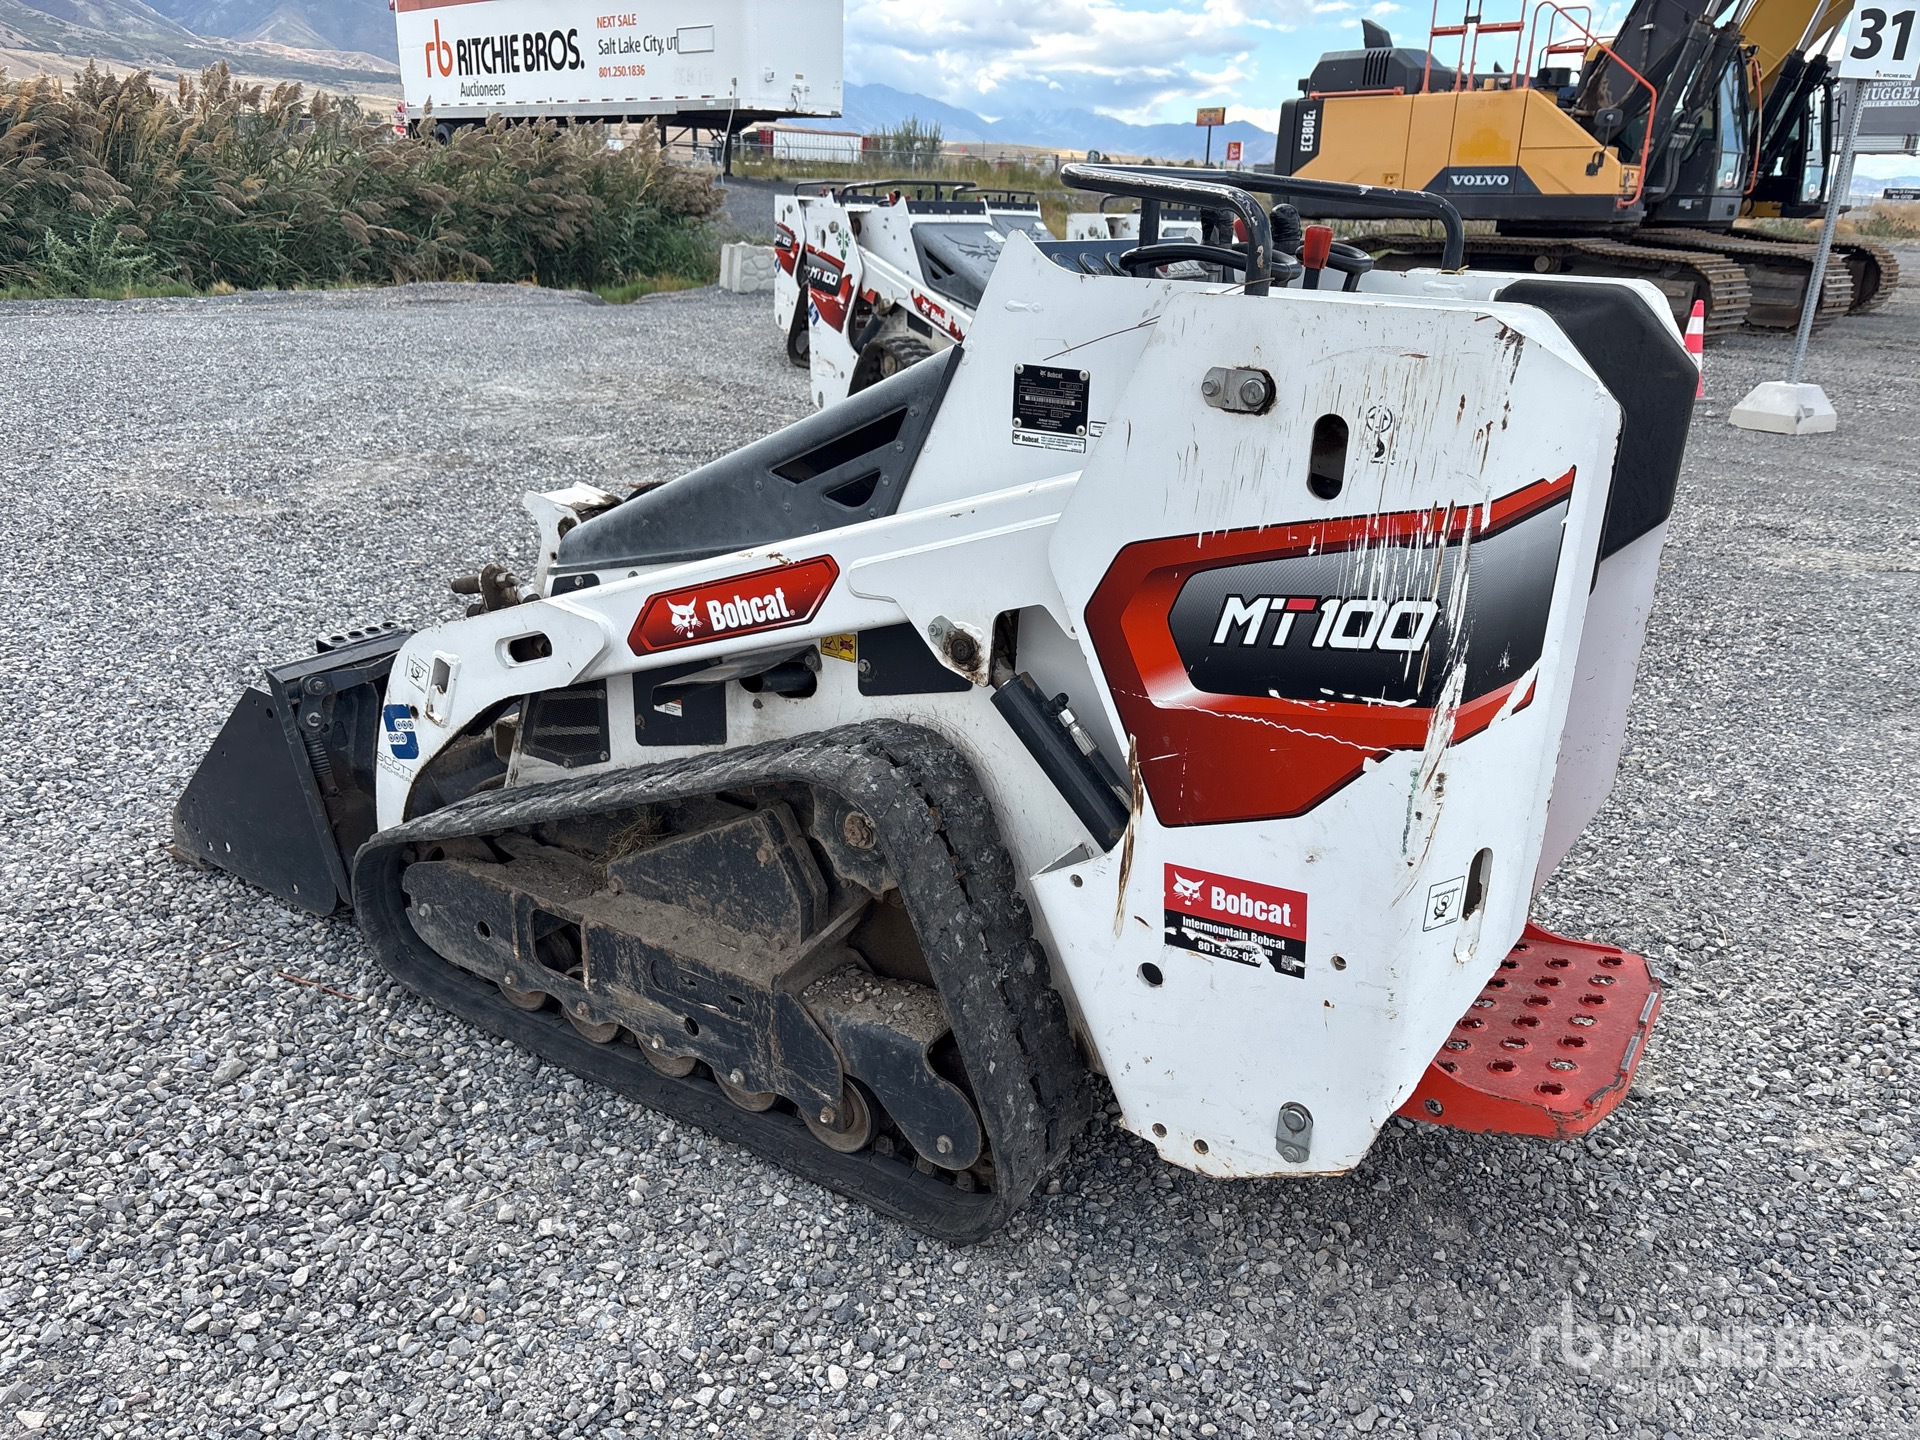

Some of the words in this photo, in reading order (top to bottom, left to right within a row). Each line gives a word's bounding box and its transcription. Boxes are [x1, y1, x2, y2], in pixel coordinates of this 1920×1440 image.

[596, 15, 616, 29] NEXT
[618, 13, 637, 27] SALE
[1849, 8, 1916, 61] 31
[425, 19, 453, 78] rb
[456, 35, 520, 76] RITCHIE
[522, 28, 585, 72] BROS.
[598, 37, 617, 55] Salt
[618, 35, 641, 54] Lake
[643, 34, 665, 56] City,
[666, 36, 678, 51] UT
[598, 64, 646, 78] 801.250.1836
[460, 79, 506, 97] Auctioneers
[1450, 174, 1510, 186] VOLVO
[1046, 371, 1064, 379] Bobcat
[1021, 435, 1040, 444] Bobcat
[705, 586, 790, 632] Bobcat
[1210, 884, 1292, 928] Bobcat
[1181, 915, 1249, 941] Intermountain
[1250, 932, 1286, 950] Bobcat
